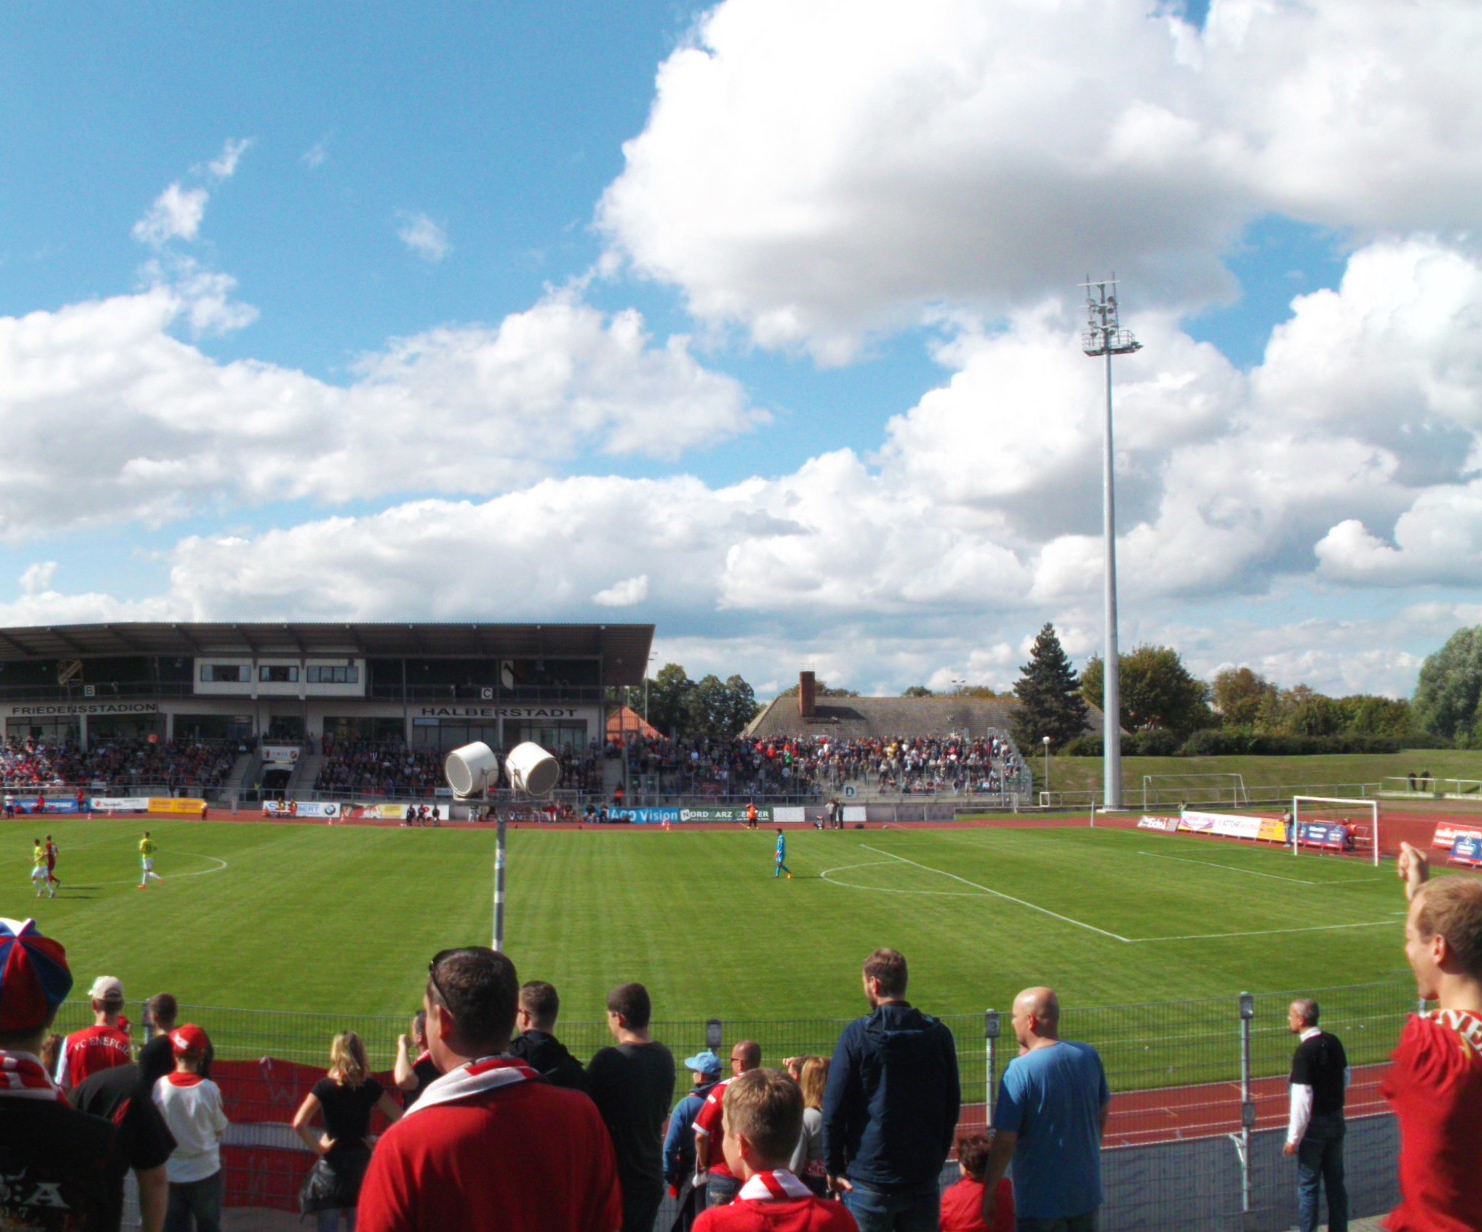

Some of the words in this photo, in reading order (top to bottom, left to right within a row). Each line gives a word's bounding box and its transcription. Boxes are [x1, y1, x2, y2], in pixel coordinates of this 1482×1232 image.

[482, 688, 492, 698] C
[11, 703, 157, 715] FRIEDENSSTADION
[421, 707, 578, 717] HALBERSTADT
[844, 786, 855, 797] D
[638, 808, 679, 821] Vision
[681, 810, 709, 820] NORD
